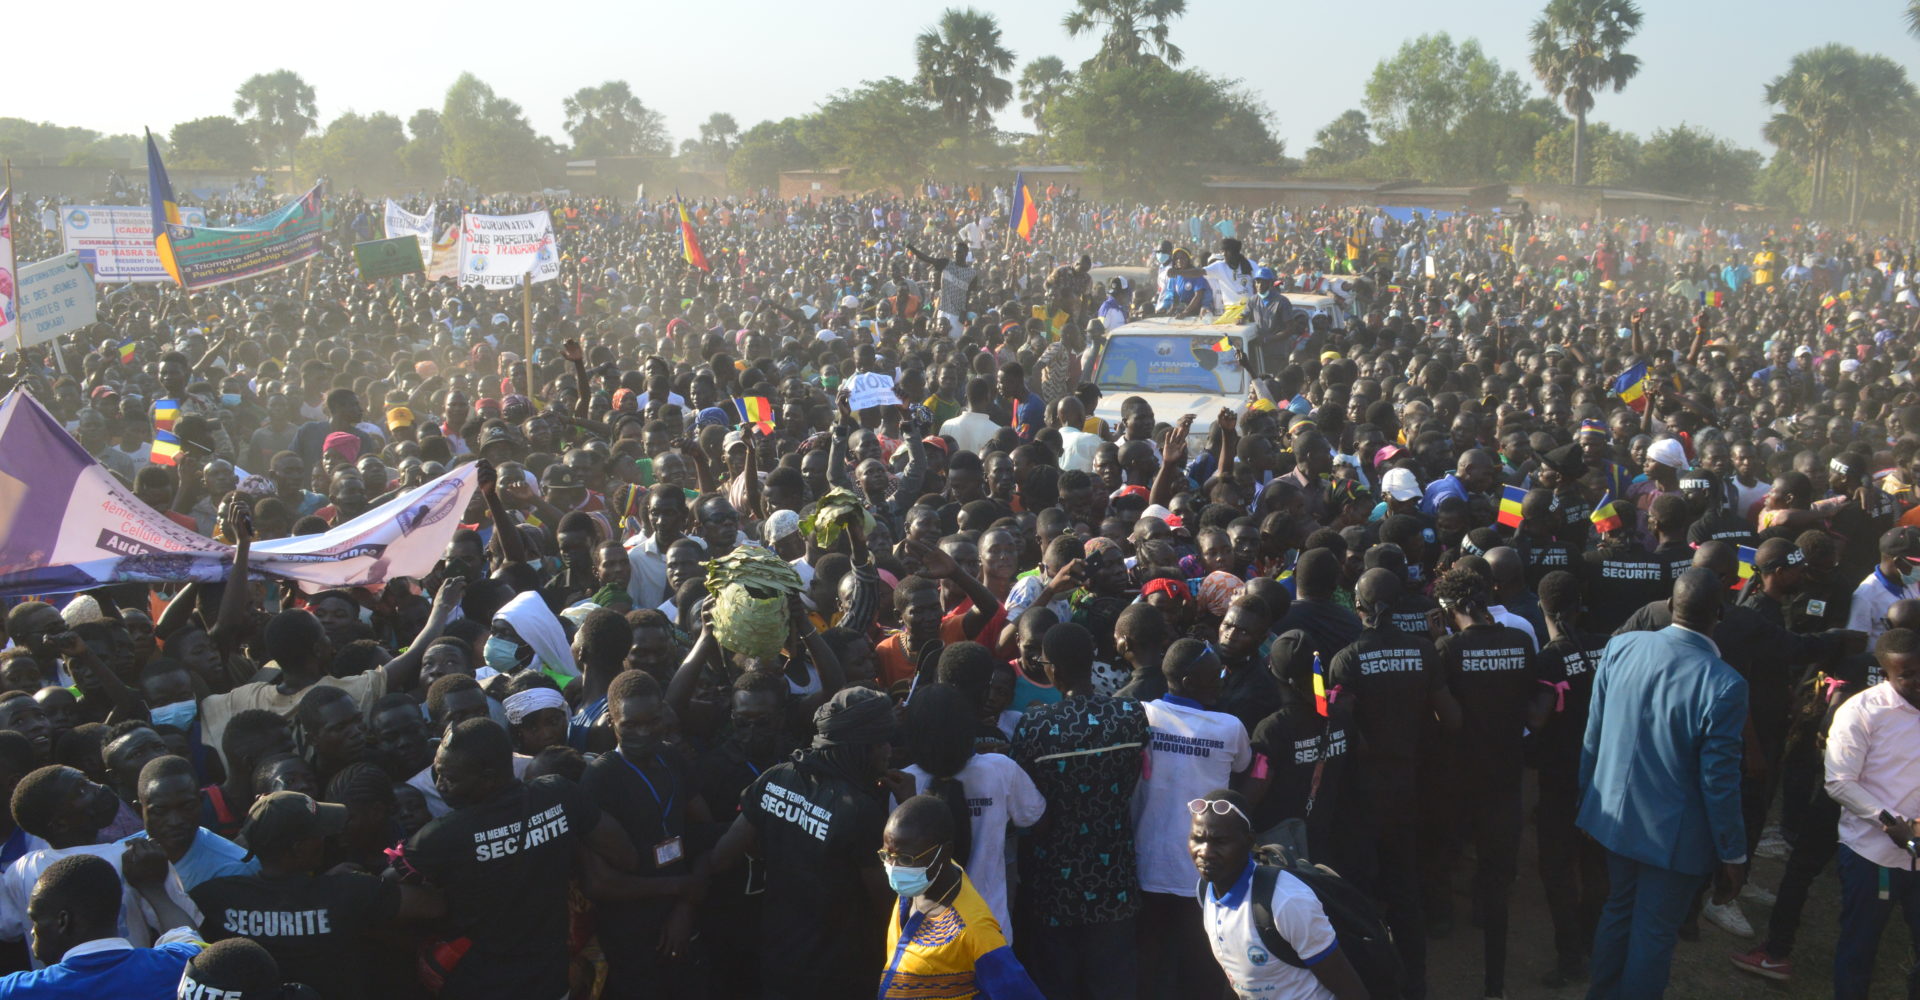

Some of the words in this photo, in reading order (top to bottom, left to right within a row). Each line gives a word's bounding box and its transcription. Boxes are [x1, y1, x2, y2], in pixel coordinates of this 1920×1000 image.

[473, 216, 534, 231] COORDINATION
[111, 249, 143, 257] MASRA
[471, 244, 489, 255] LES
[194, 256, 242, 272] Triomphe
[216, 266, 229, 274] du
[231, 253, 281, 272] Leadership
[855, 374, 893, 393] NON
[120, 521, 162, 545] Cellule
[1602, 567, 1661, 580] SECURITE
[1393, 649, 1404, 657] EST
[1462, 657, 1526, 671] SECURITE
[1156, 732, 1225, 749] TRANSFORMATEURS
[1152, 741, 1211, 758] MOUNDOU
[487, 825, 510, 840] MEME
[532, 812, 545, 826] EST
[544, 803, 564, 820] MIEUX
[224, 908, 332, 937] SECURITE
